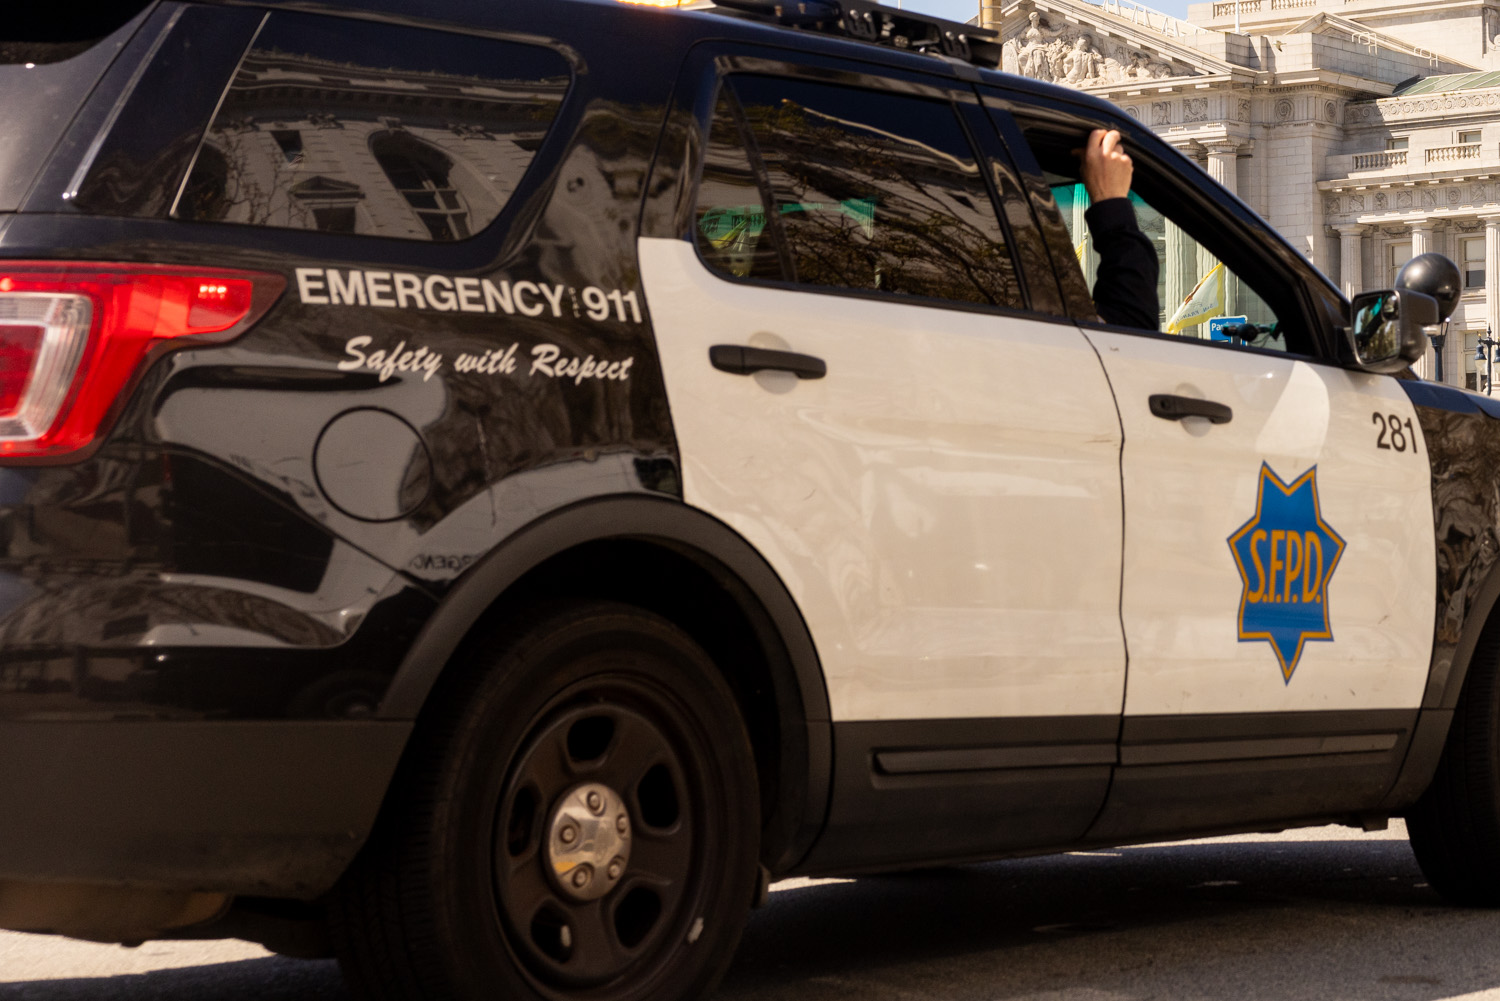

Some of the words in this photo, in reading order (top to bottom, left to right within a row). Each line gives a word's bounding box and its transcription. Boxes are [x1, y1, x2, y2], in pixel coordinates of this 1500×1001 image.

[295, 268, 564, 318] EMERGENCY
[582, 286, 642, 323] 911
[337, 335, 443, 382] Safety
[453, 342, 519, 375] with
[529, 343, 634, 386] Respect
[1372, 411, 1418, 454] 281
[1247, 529, 1323, 603] S.F.P.D.
